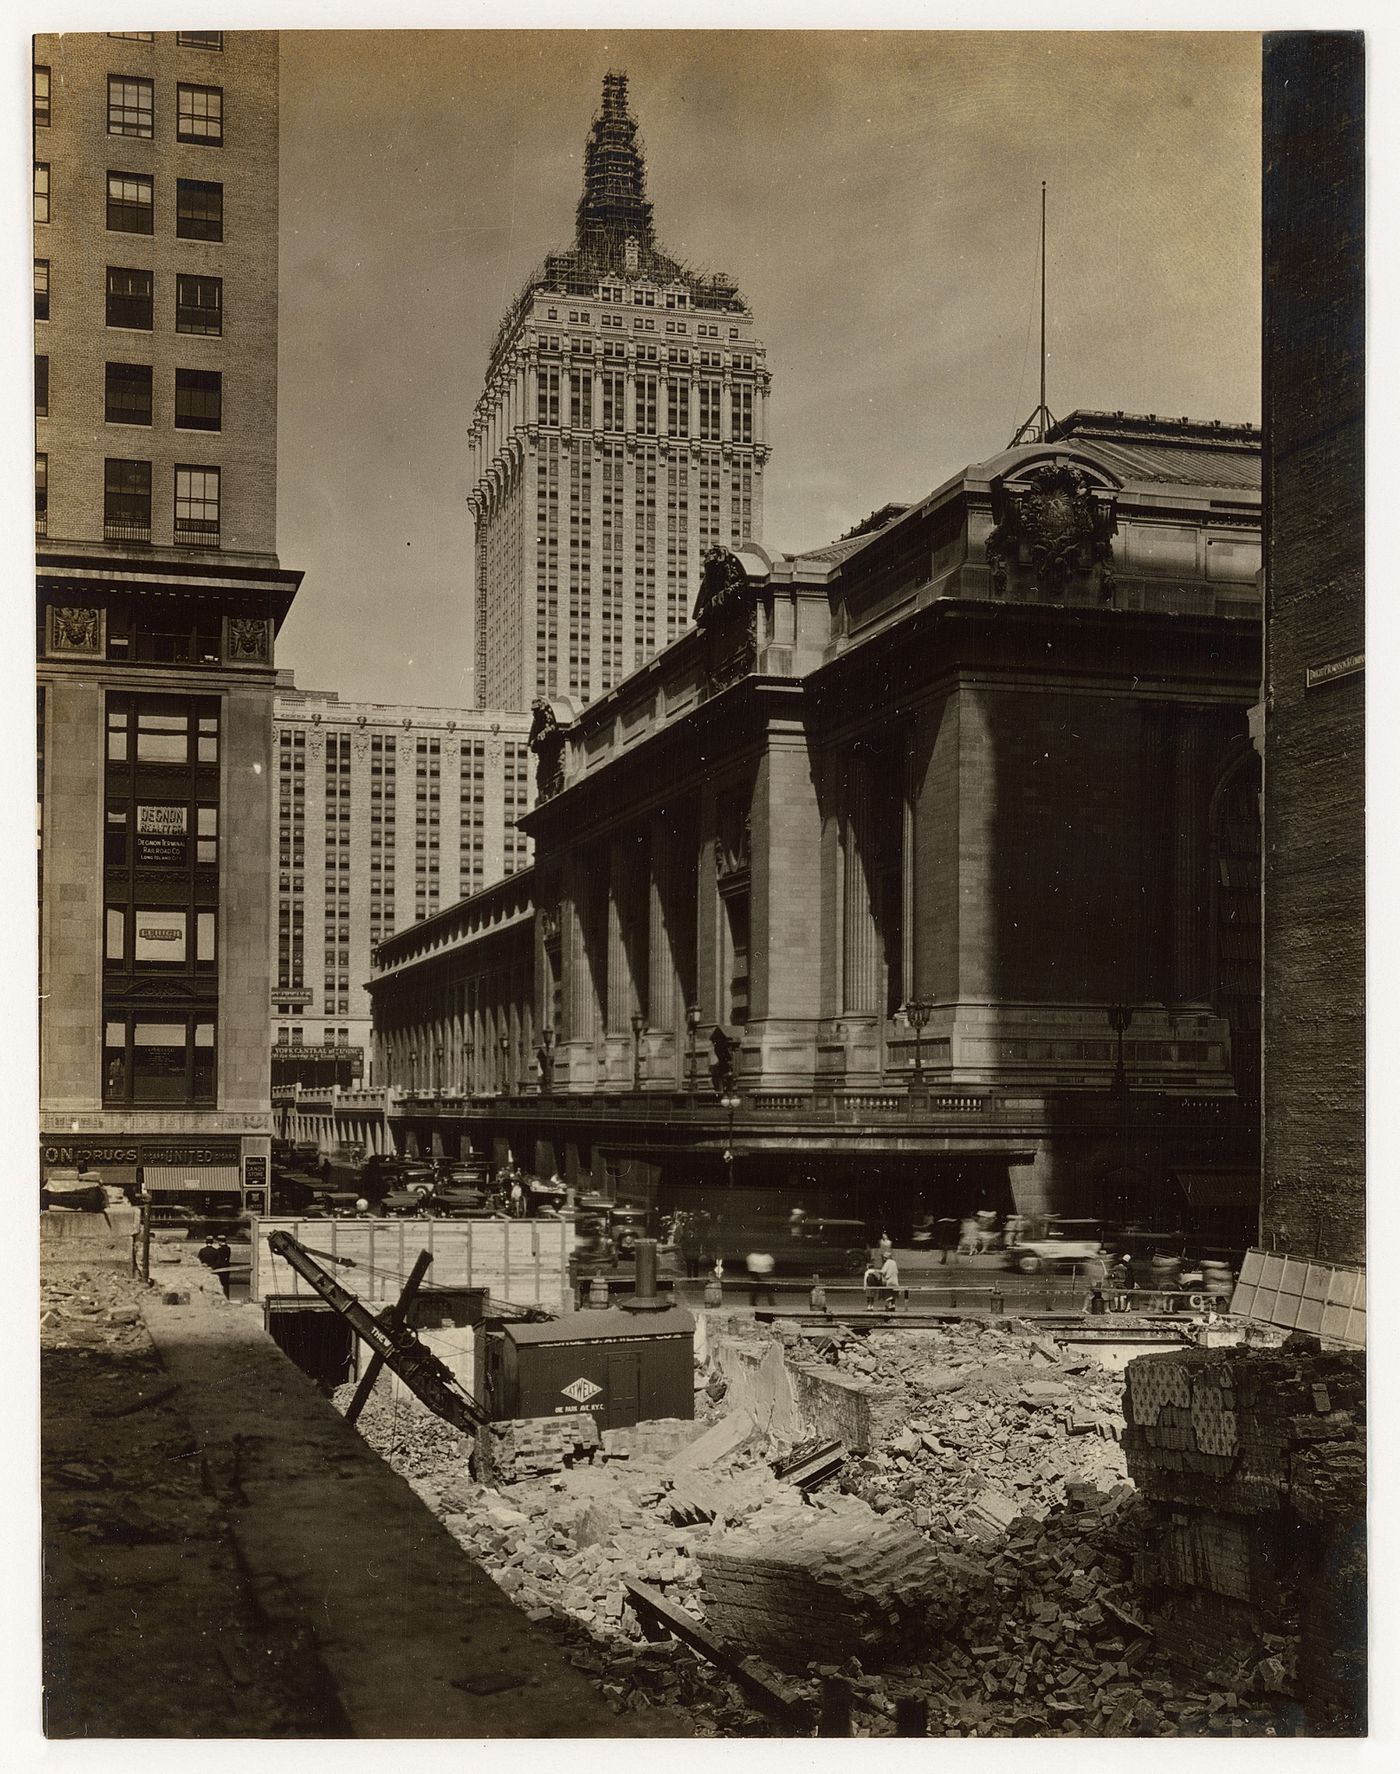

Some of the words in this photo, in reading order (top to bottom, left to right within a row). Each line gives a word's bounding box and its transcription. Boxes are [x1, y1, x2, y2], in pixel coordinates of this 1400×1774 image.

[141, 807, 183, 823] DEGNON
[143, 846, 171, 854] RAILROAD
[165, 1149, 212, 1162] UNITED
[371, 1327, 392, 1347] THEW
[565, 1379, 600, 1402] ATWELL
